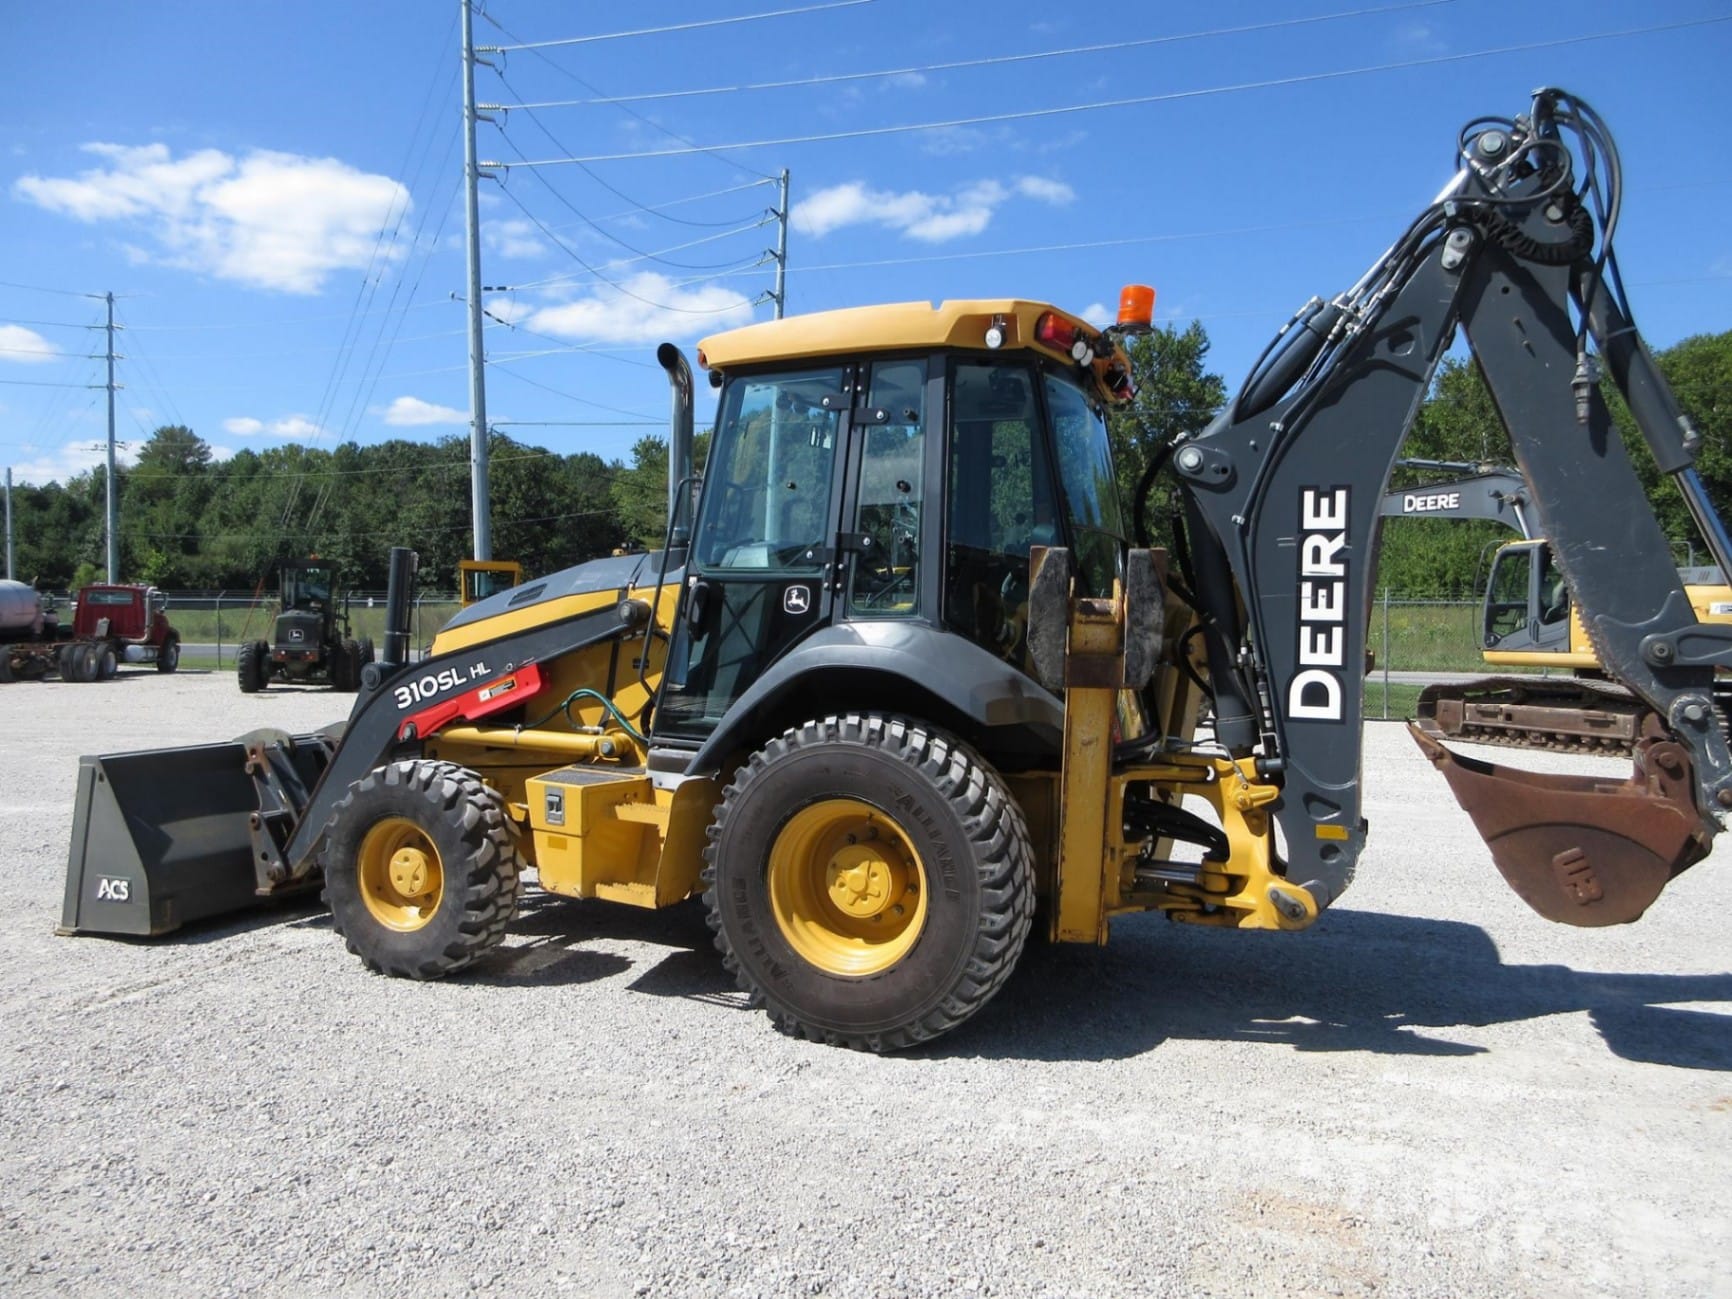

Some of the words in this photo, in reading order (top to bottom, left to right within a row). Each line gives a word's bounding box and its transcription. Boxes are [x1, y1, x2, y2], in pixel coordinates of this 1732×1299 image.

[1404, 493, 1460, 512] DEERE
[1289, 490, 1346, 720] DEERE
[394, 667, 467, 709] 310SL
[469, 662, 491, 679] HL
[97, 878, 129, 900] ACS
